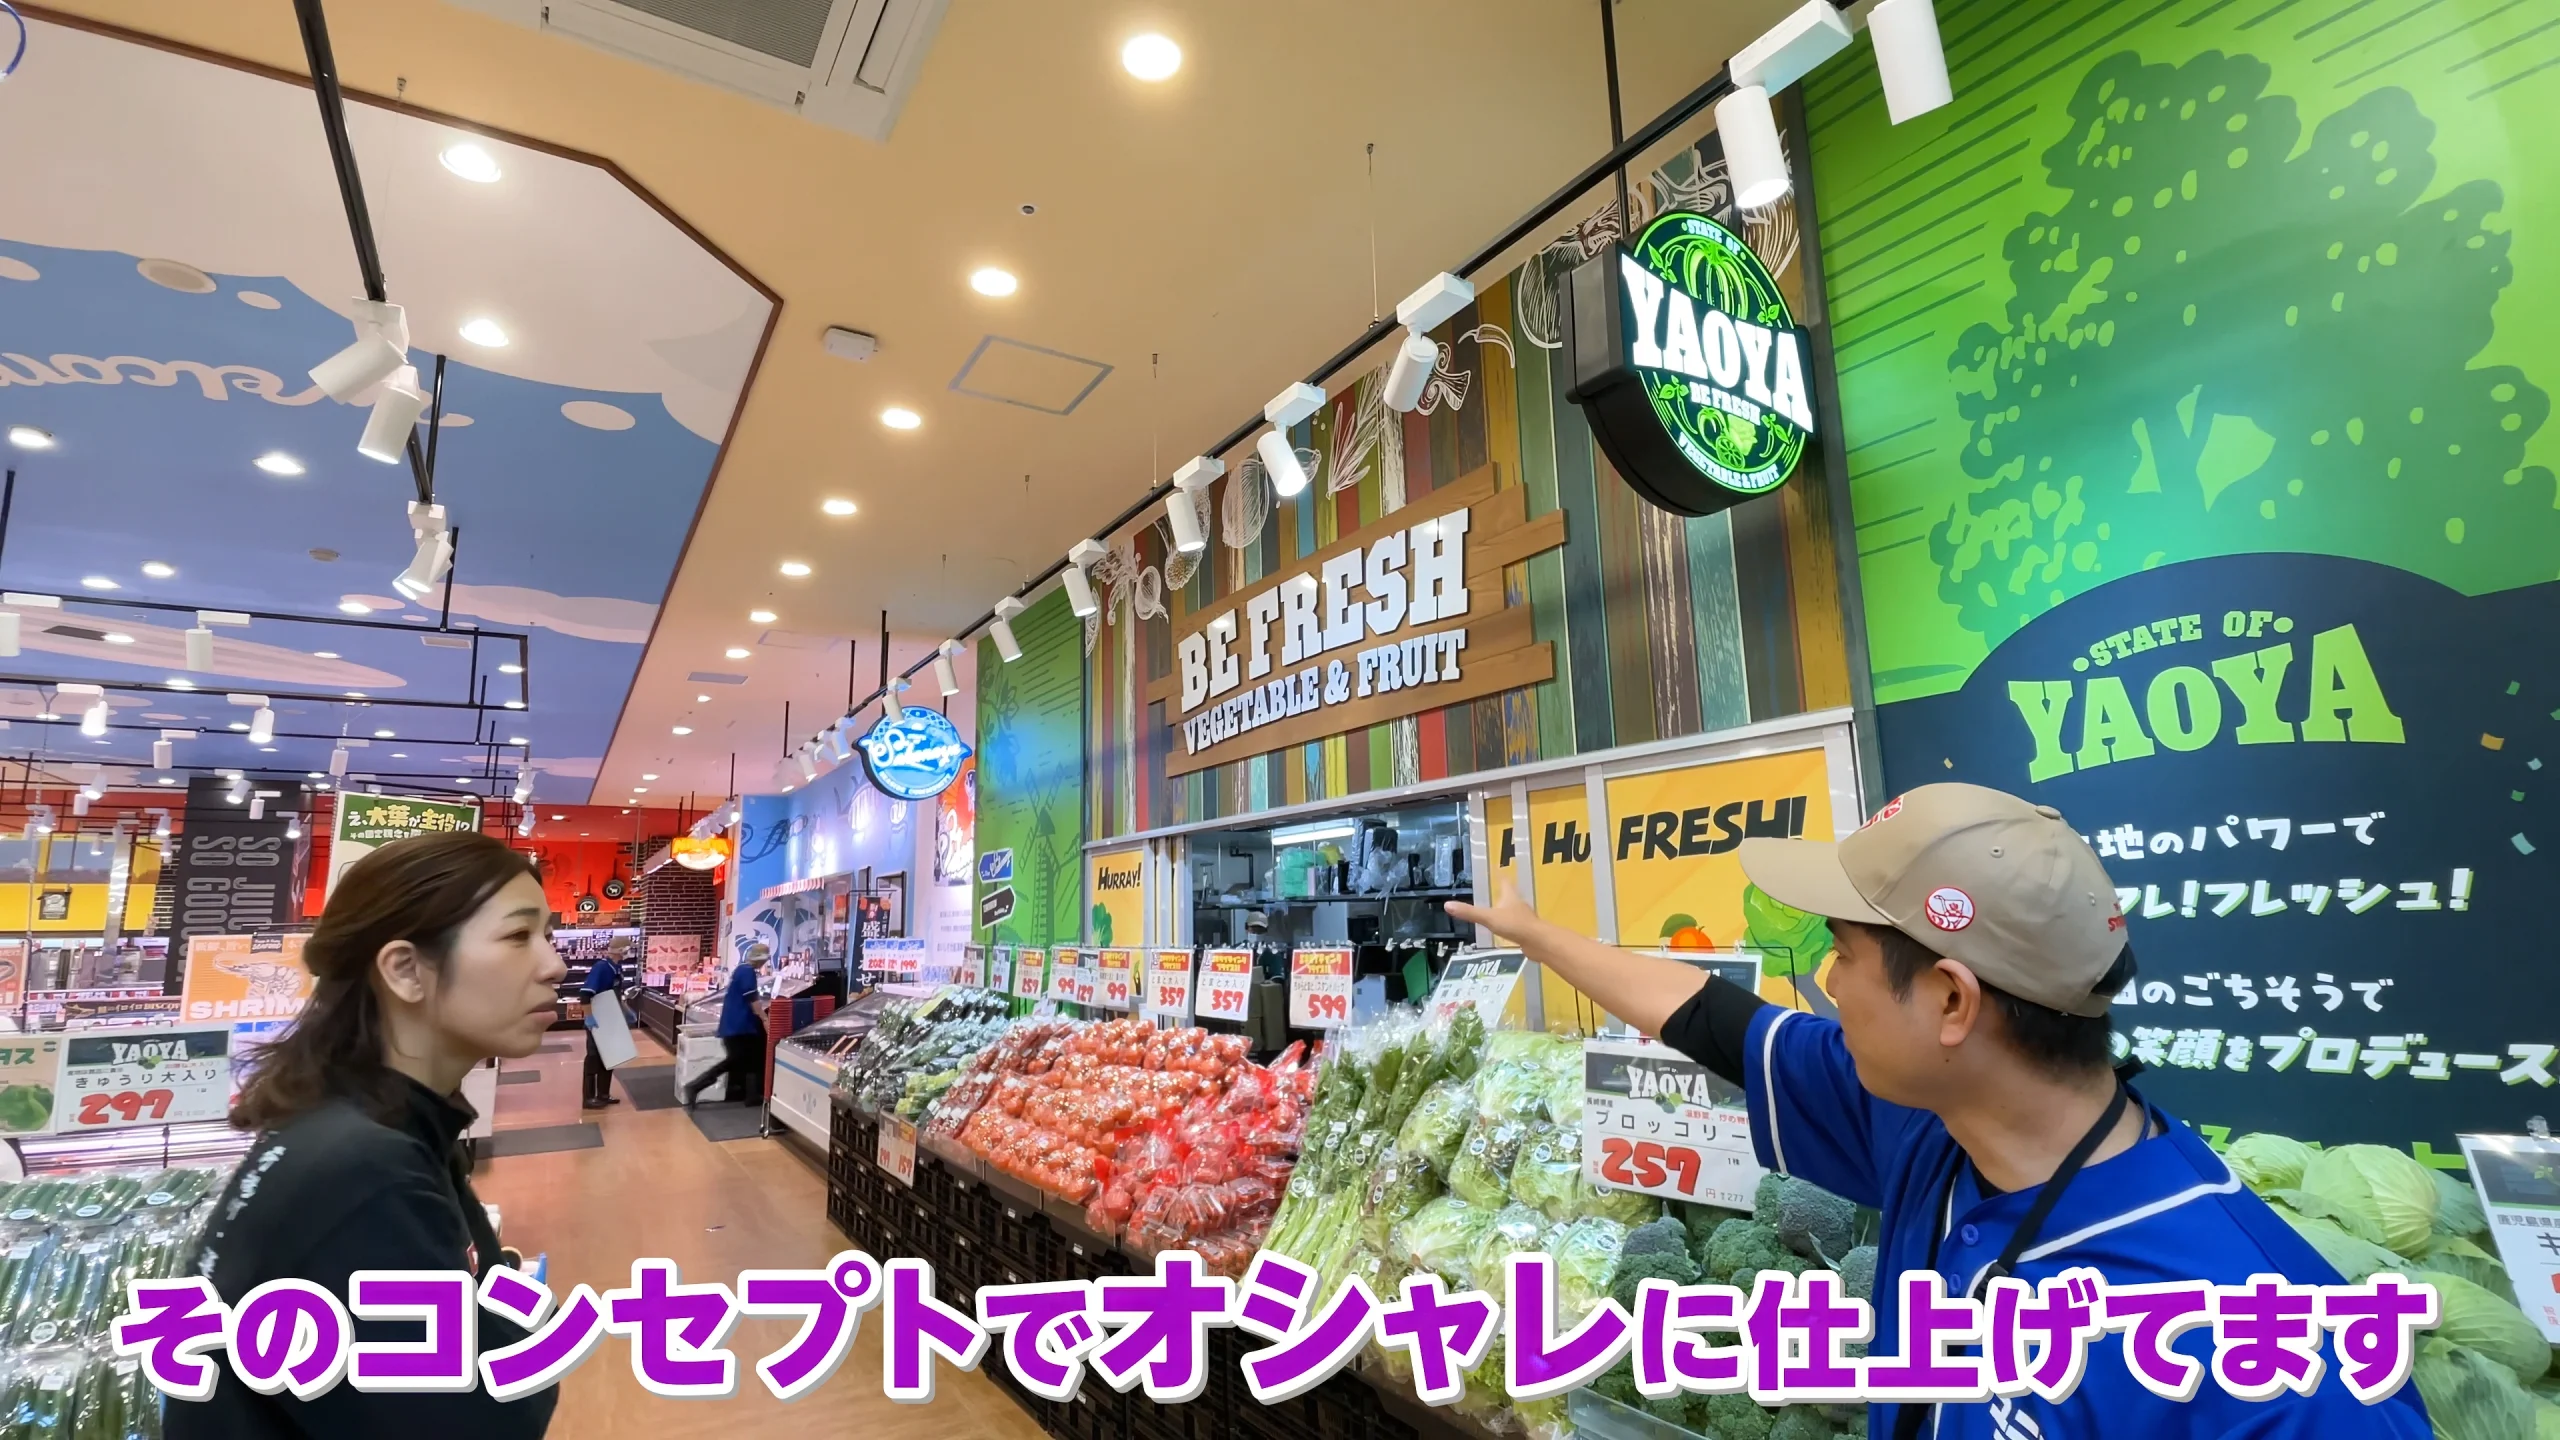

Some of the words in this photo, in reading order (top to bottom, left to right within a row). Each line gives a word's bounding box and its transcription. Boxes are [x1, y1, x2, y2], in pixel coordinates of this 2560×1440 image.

[1621, 253, 1813, 433] YAOYA
[1689, 381, 1711, 406] BE
[1711, 387, 1761, 426] FRESH
[1679, 431, 1743, 488] VEGETABLE
[1177, 608, 1240, 714] BE
[1246, 507, 1470, 681] FRESH
[2088, 614, 2203, 667] STATE
[2223, 610, 2274, 639] OF
[1182, 675, 1321, 756] VEGETABLE
[1323, 660, 1350, 706] &
[1357, 628, 1467, 698] FRUIT
[2007, 623, 2407, 783] YAOYA
[2080, 811, 2386, 860] 地のパワーで
[1107, 982, 1128, 1001] 99
[1159, 986, 1186, 1008] 357
[1211, 989, 1244, 1013] 357
[1308, 994, 1347, 1020] 599
[111, 1039, 189, 1065] YAOYA
[75, 1069, 217, 1089] きゅうり大入り
[1627, 1065, 1713, 1110] YAOYA
[78, 1089, 174, 1125] 297
[1596, 1111, 1747, 1141] ブロッコリー
[1601, 1137, 1702, 1196] 257
